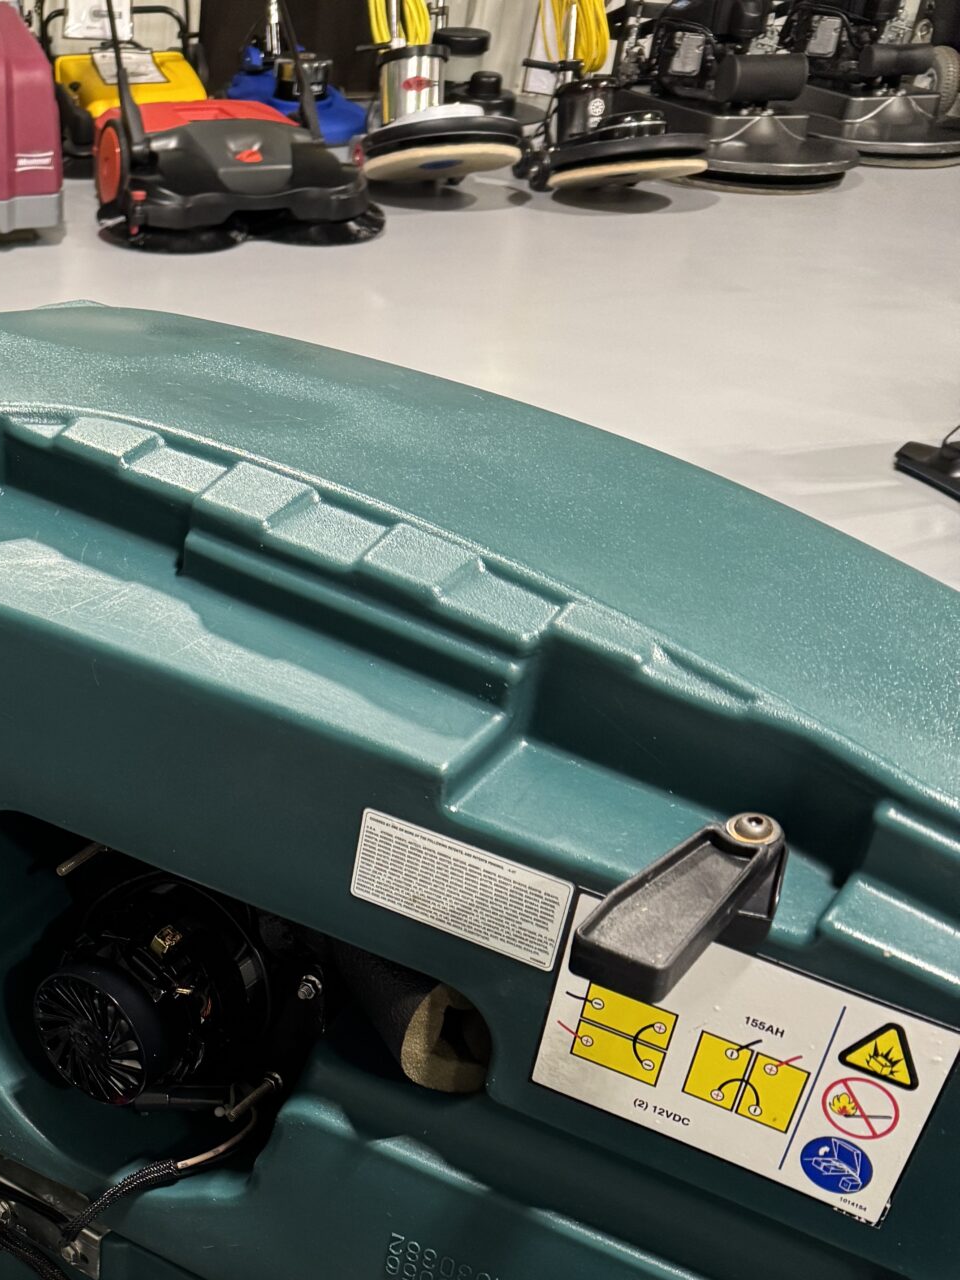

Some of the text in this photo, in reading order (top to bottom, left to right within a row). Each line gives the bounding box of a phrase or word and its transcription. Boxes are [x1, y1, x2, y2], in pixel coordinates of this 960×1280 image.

[744, 1016, 785, 1038] 155AH
[633, 1098, 691, 1127] (2) 12VDC
